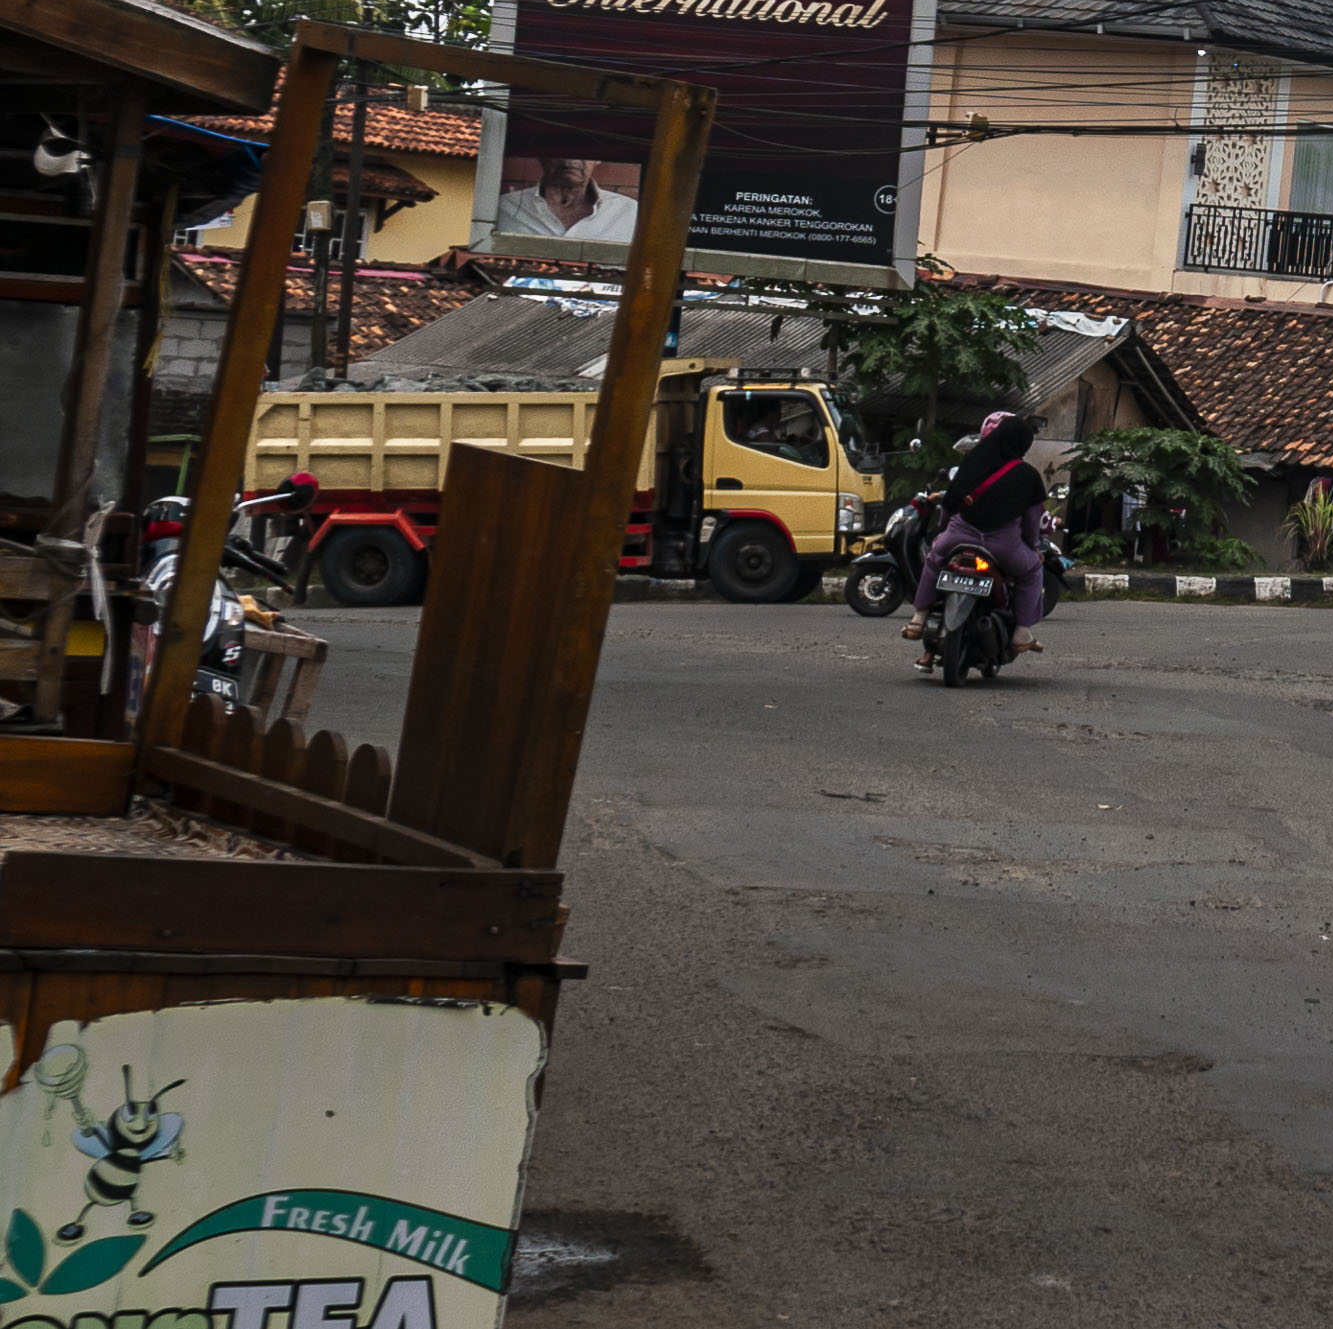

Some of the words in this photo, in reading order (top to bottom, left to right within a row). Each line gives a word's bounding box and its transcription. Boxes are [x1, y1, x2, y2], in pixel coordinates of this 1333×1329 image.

[735, 191, 813, 205] PERINGATAN:
[724, 204, 766, 215] KARENA
[699, 214, 748, 224] TERKENA
[749, 218, 791, 228] KANKER
[794, 219, 873, 232] TENGGOROKAN
[711, 227, 758, 237] BERHENTI
[759, 230, 806, 240] MEROKOK
[942, 574, 948, 582] A
[386, 1217, 472, 1275] Milk
